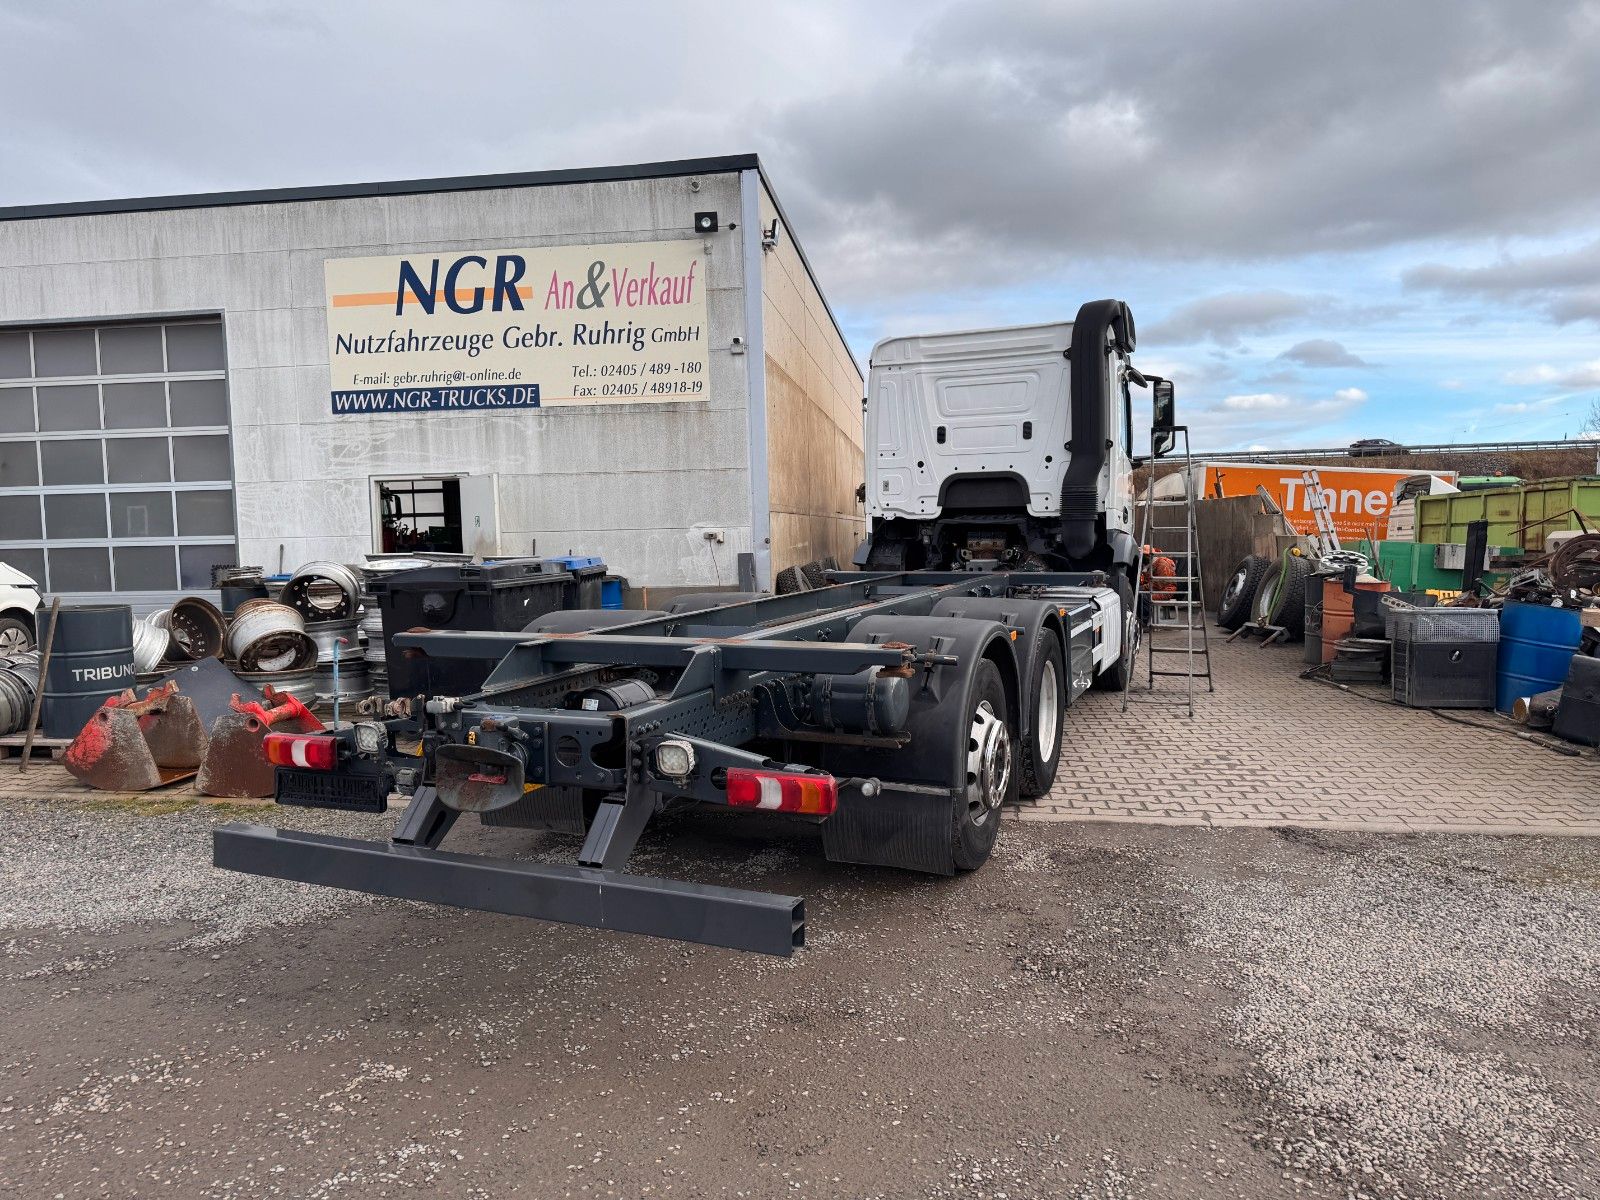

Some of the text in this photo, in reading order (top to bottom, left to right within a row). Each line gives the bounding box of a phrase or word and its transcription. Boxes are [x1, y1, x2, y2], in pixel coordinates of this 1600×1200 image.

[395, 254, 527, 316] NGR
[335, 320, 700, 358] Nutzfahrzeuge Gebr. Ruhrig GmbH
[353, 368, 522, 388] E-mail: gebr.ruhrig@t-online.de
[572, 364, 597, 378] Tel.:
[600, 364, 637, 377] 02405
[639, 362, 647, 377] /
[649, 363, 671, 375] 489
[335, 387, 536, 411] WWW.NGR-TRUCKS.DE
[573, 380, 703, 397] Fax: 02405 / 48918-19
[1279, 477, 1394, 516] Tinne
